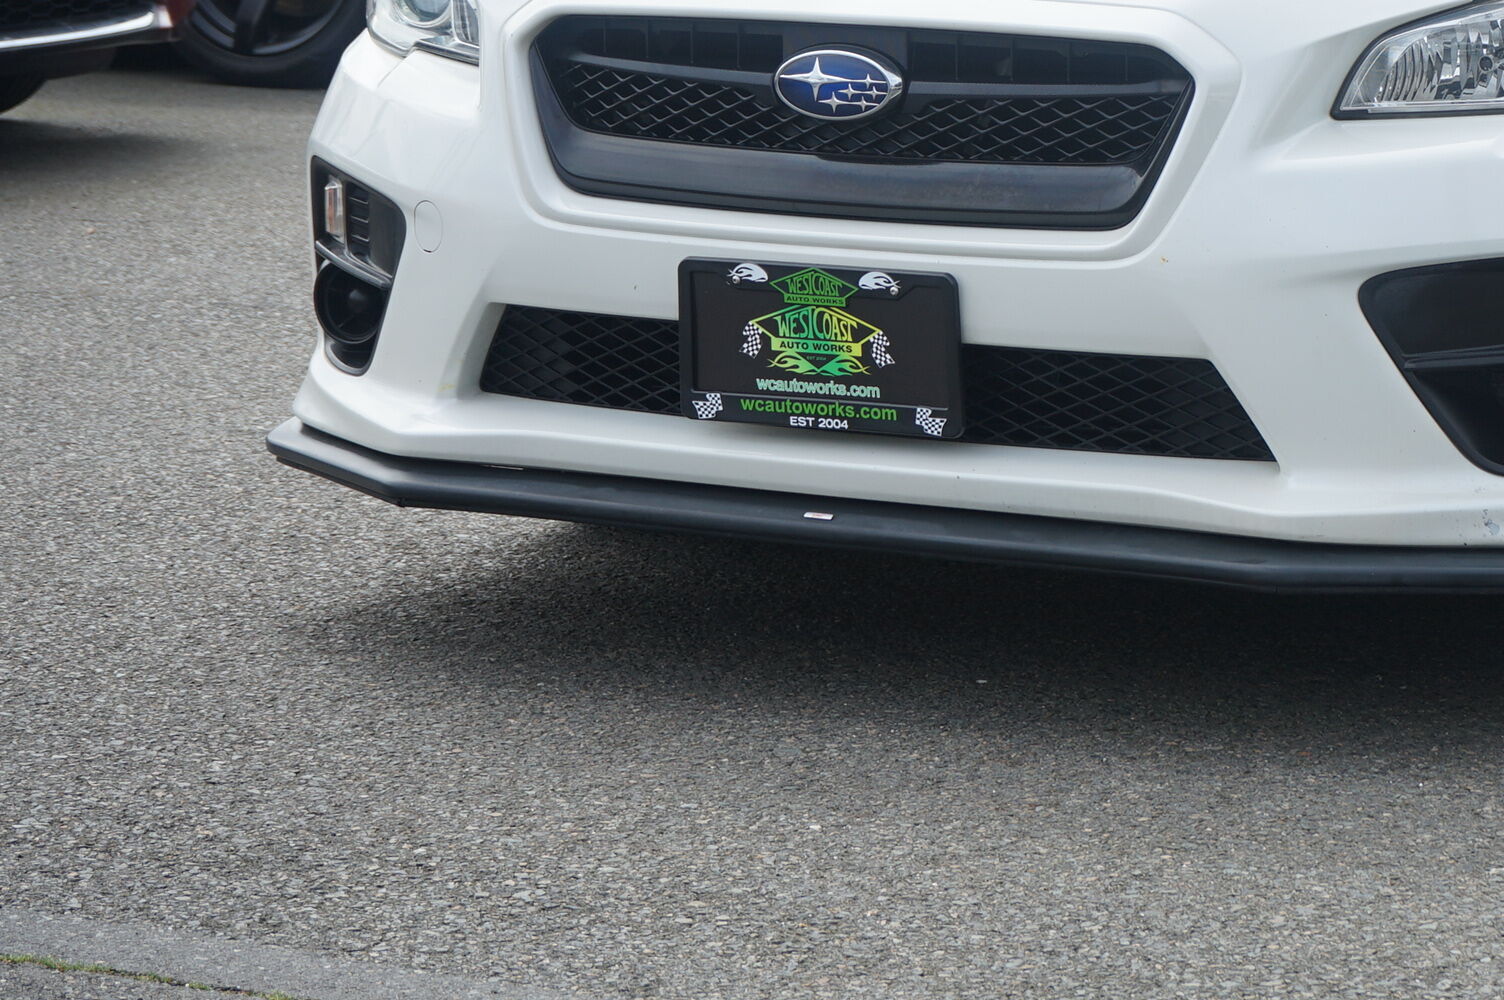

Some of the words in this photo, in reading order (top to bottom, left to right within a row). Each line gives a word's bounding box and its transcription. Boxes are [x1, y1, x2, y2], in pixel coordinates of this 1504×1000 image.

[786, 295, 810, 303] AUTO
[812, 297, 844, 305] WORKS
[779, 340, 809, 350] AUTO
[812, 343, 853, 353] WORKS
[756, 378, 881, 398] wcautoworks.com
[740, 398, 897, 421] wcautoworks.com
[789, 416, 815, 427] EST
[818, 418, 849, 430] 2004
